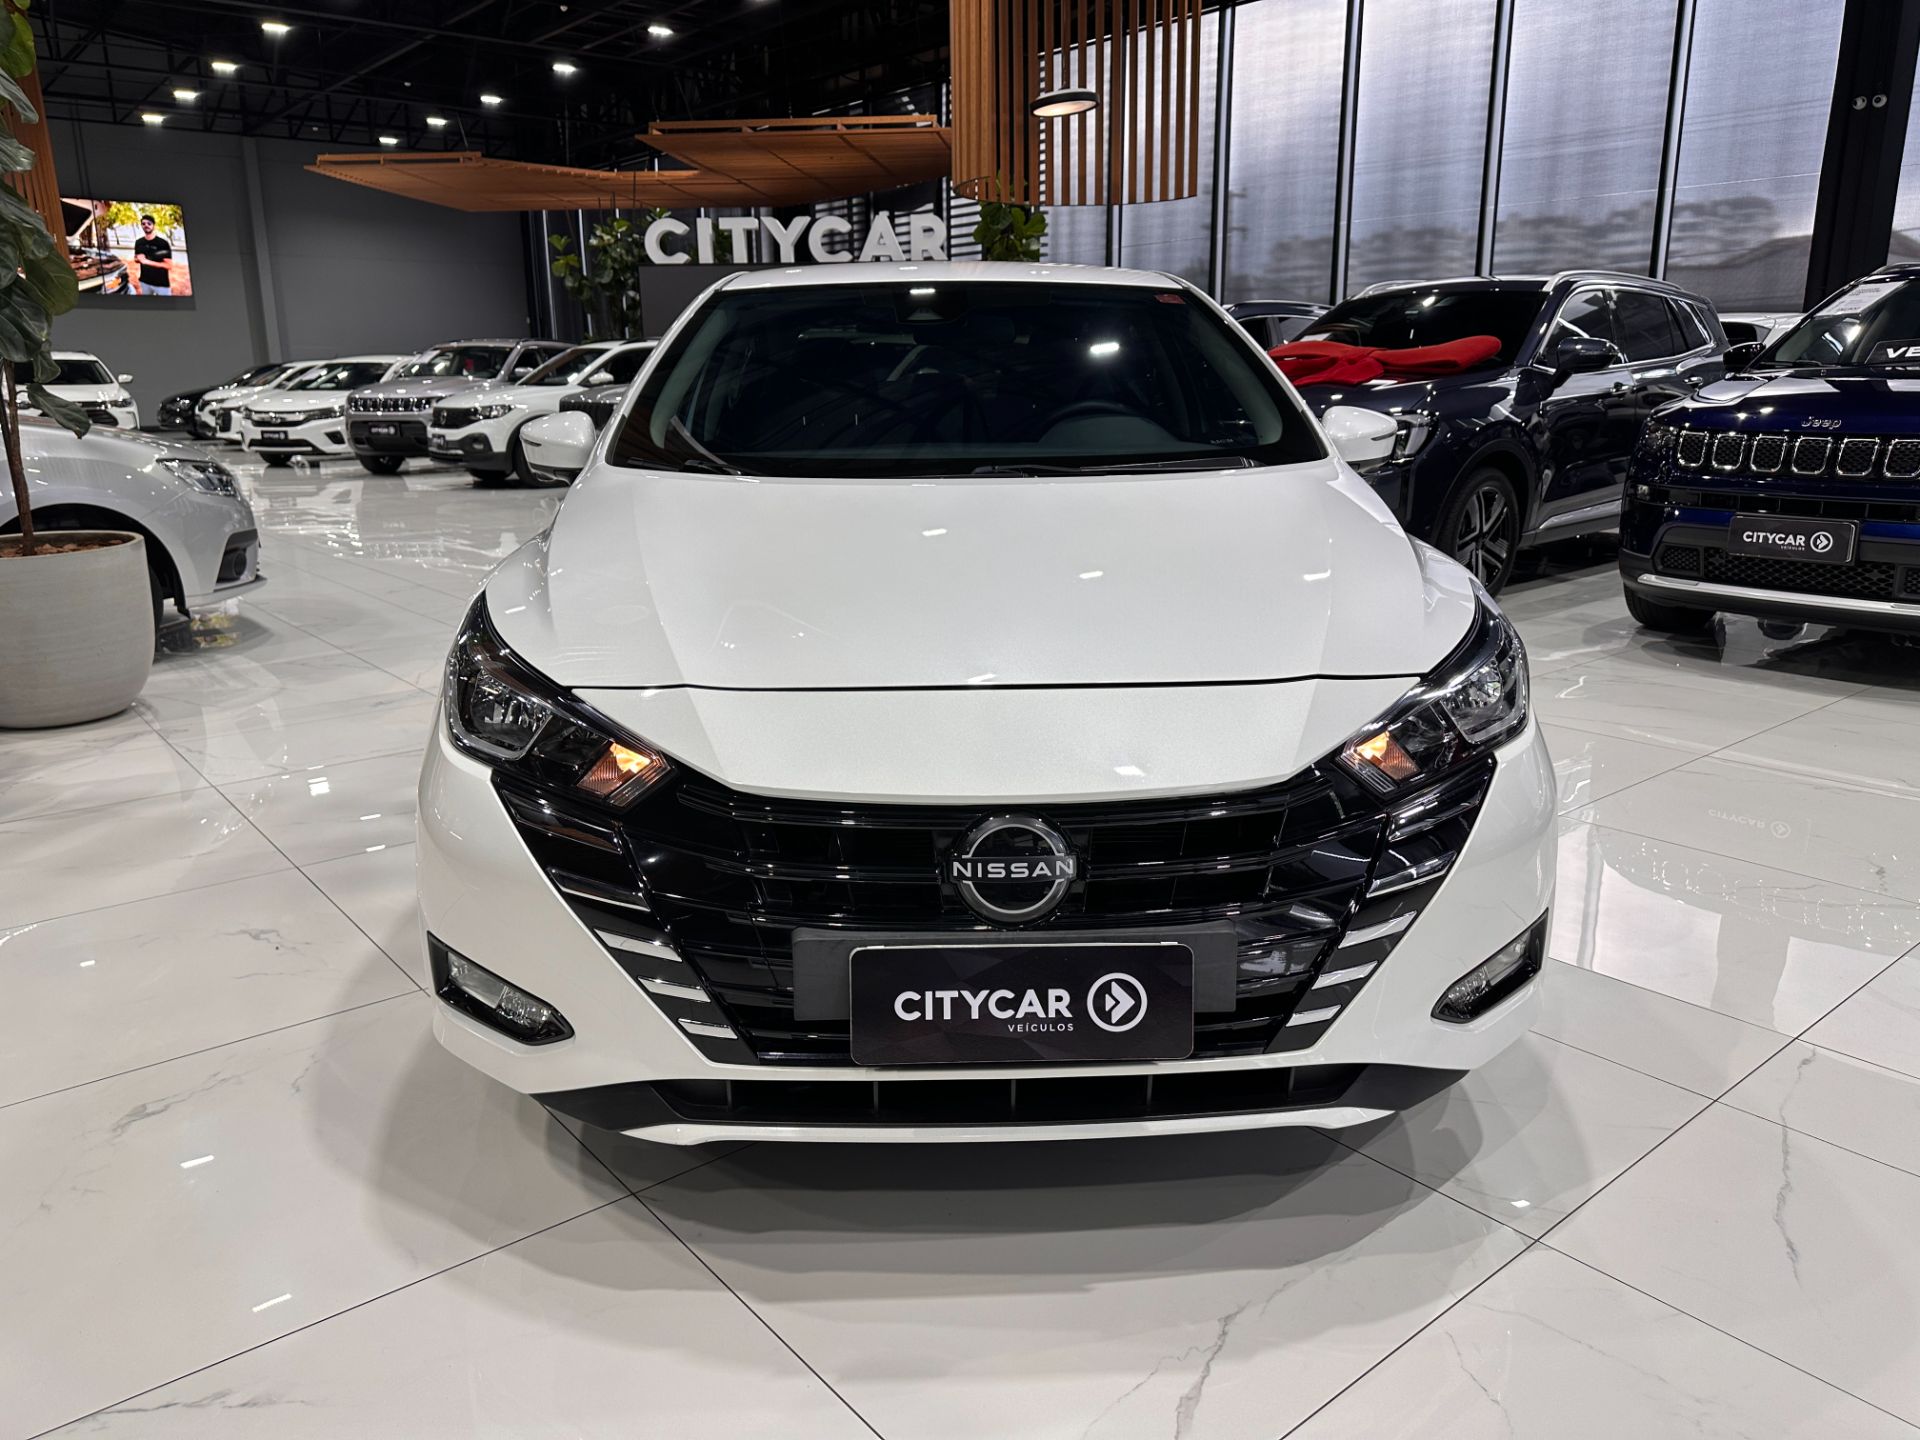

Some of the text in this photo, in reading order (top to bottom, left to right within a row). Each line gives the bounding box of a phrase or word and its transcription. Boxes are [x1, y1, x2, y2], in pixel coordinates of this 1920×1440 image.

[644, 210, 949, 265] CITYCAR
[1801, 416, 1842, 430] Jeep
[1742, 531, 1806, 546] CITYCAR
[952, 860, 1075, 879] NISSAN
[894, 988, 1074, 1021] CITYCAR
[1008, 1023, 1074, 1033] VEÍCULOS
